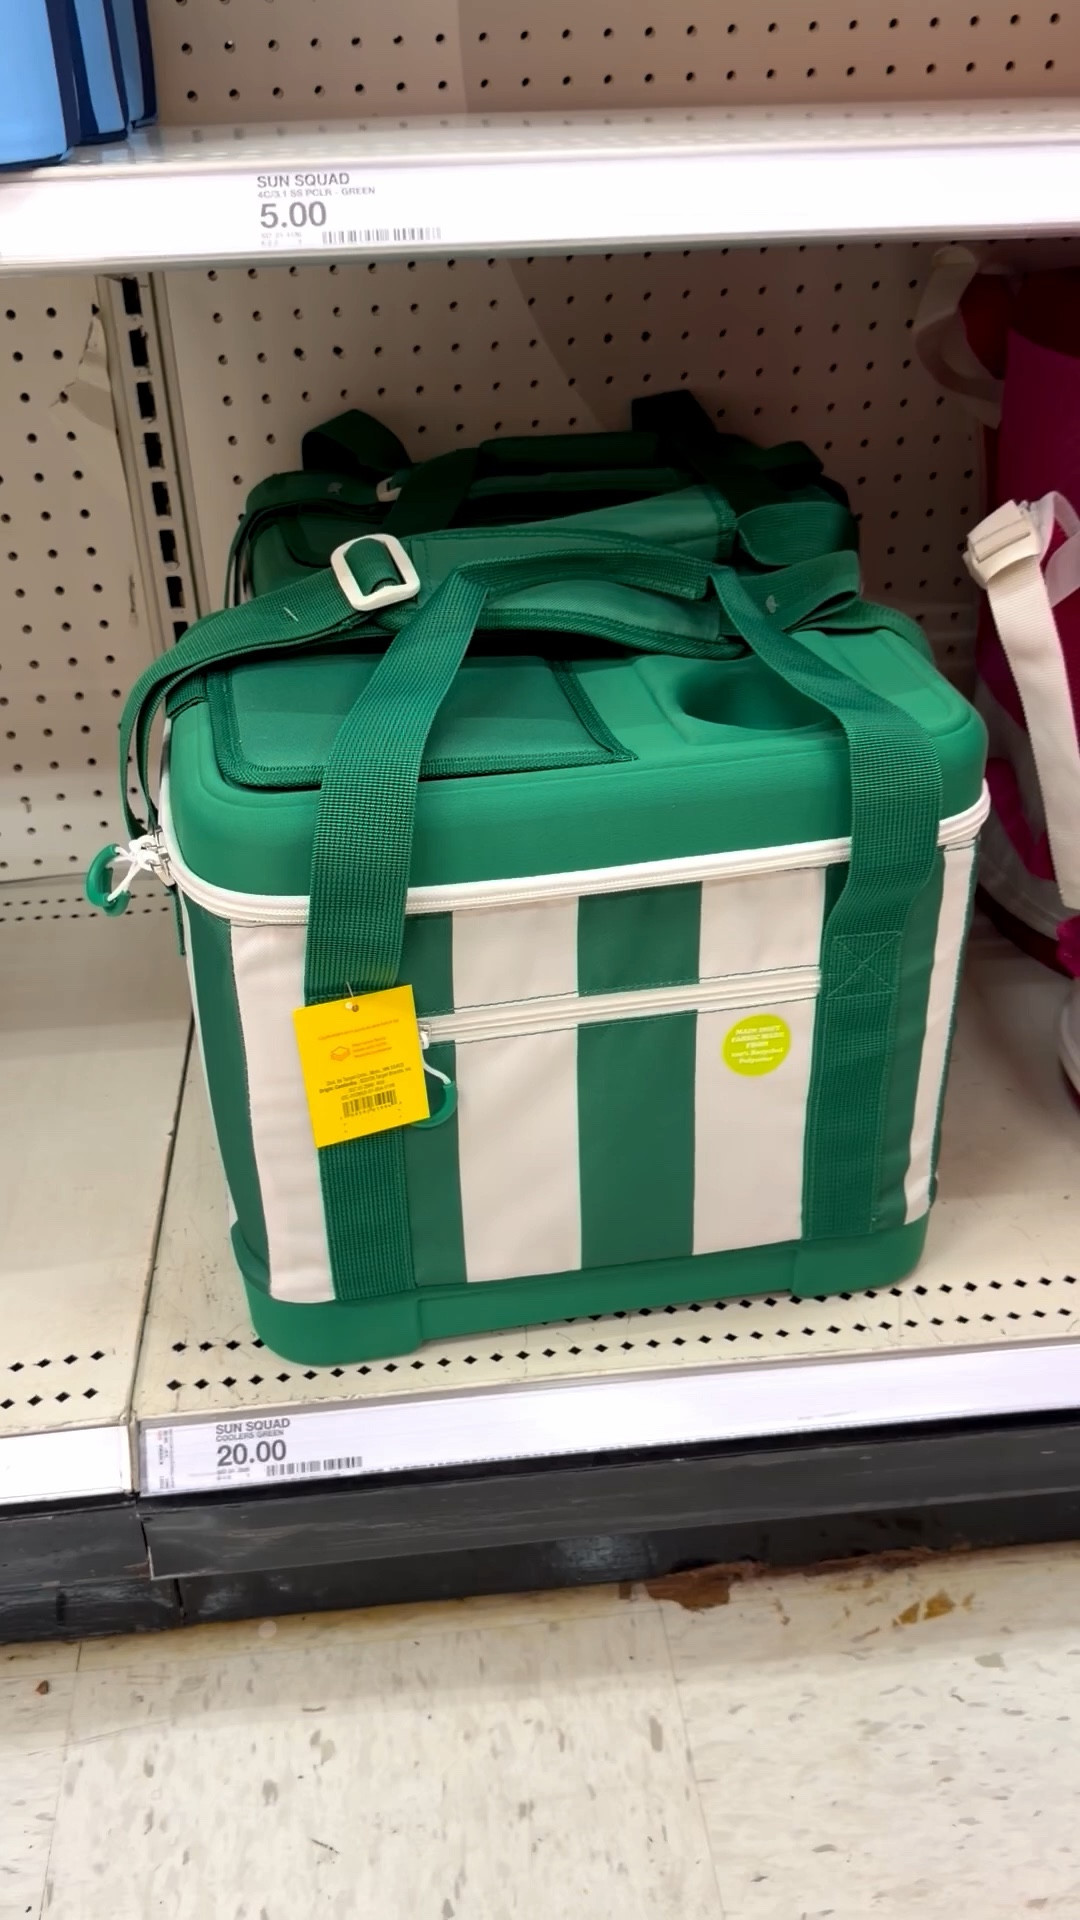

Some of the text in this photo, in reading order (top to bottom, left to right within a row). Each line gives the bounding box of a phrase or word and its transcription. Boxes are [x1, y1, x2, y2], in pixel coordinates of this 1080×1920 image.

[257, 172, 350, 188] SUN SQUAD
[341, 186, 376, 196] GREEN
[260, 200, 327, 229] 5.00
[215, 1417, 291, 1435] SUN SQUAD
[215, 1429, 284, 1443] COOLERS GREEN
[217, 1439, 287, 1467] 20.00
